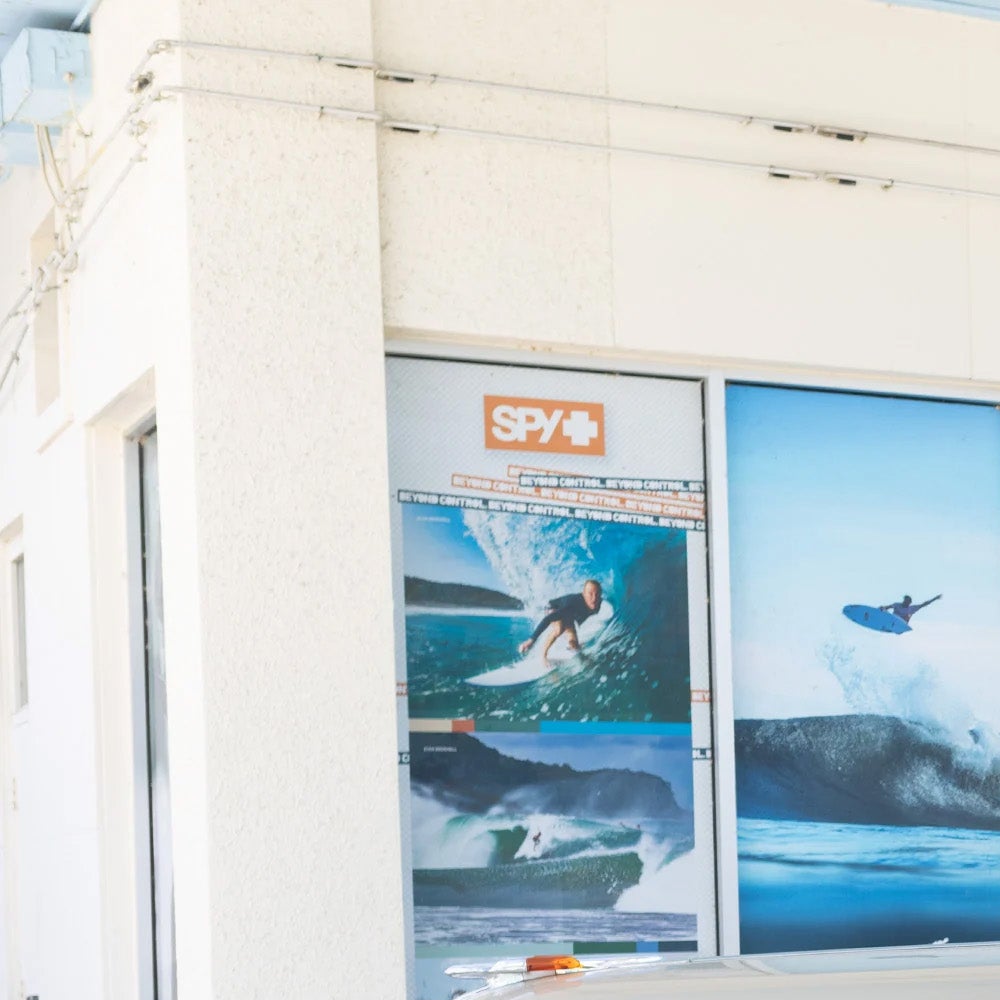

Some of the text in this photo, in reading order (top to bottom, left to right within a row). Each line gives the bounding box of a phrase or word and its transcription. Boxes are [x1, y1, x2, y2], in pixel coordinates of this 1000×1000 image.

[452, 475, 491, 490] BEYOND
[541, 488, 577, 502] BEYOND
[625, 499, 662, 513] BEYOND
[520, 475, 558, 487] BEYOND
[606, 478, 643, 490] BEYOND
[399, 490, 438, 505] BEYOND
[488, 500, 527, 513] BEYOND
[574, 508, 612, 522] BEYOND
[658, 517, 695, 530] BEYOND
